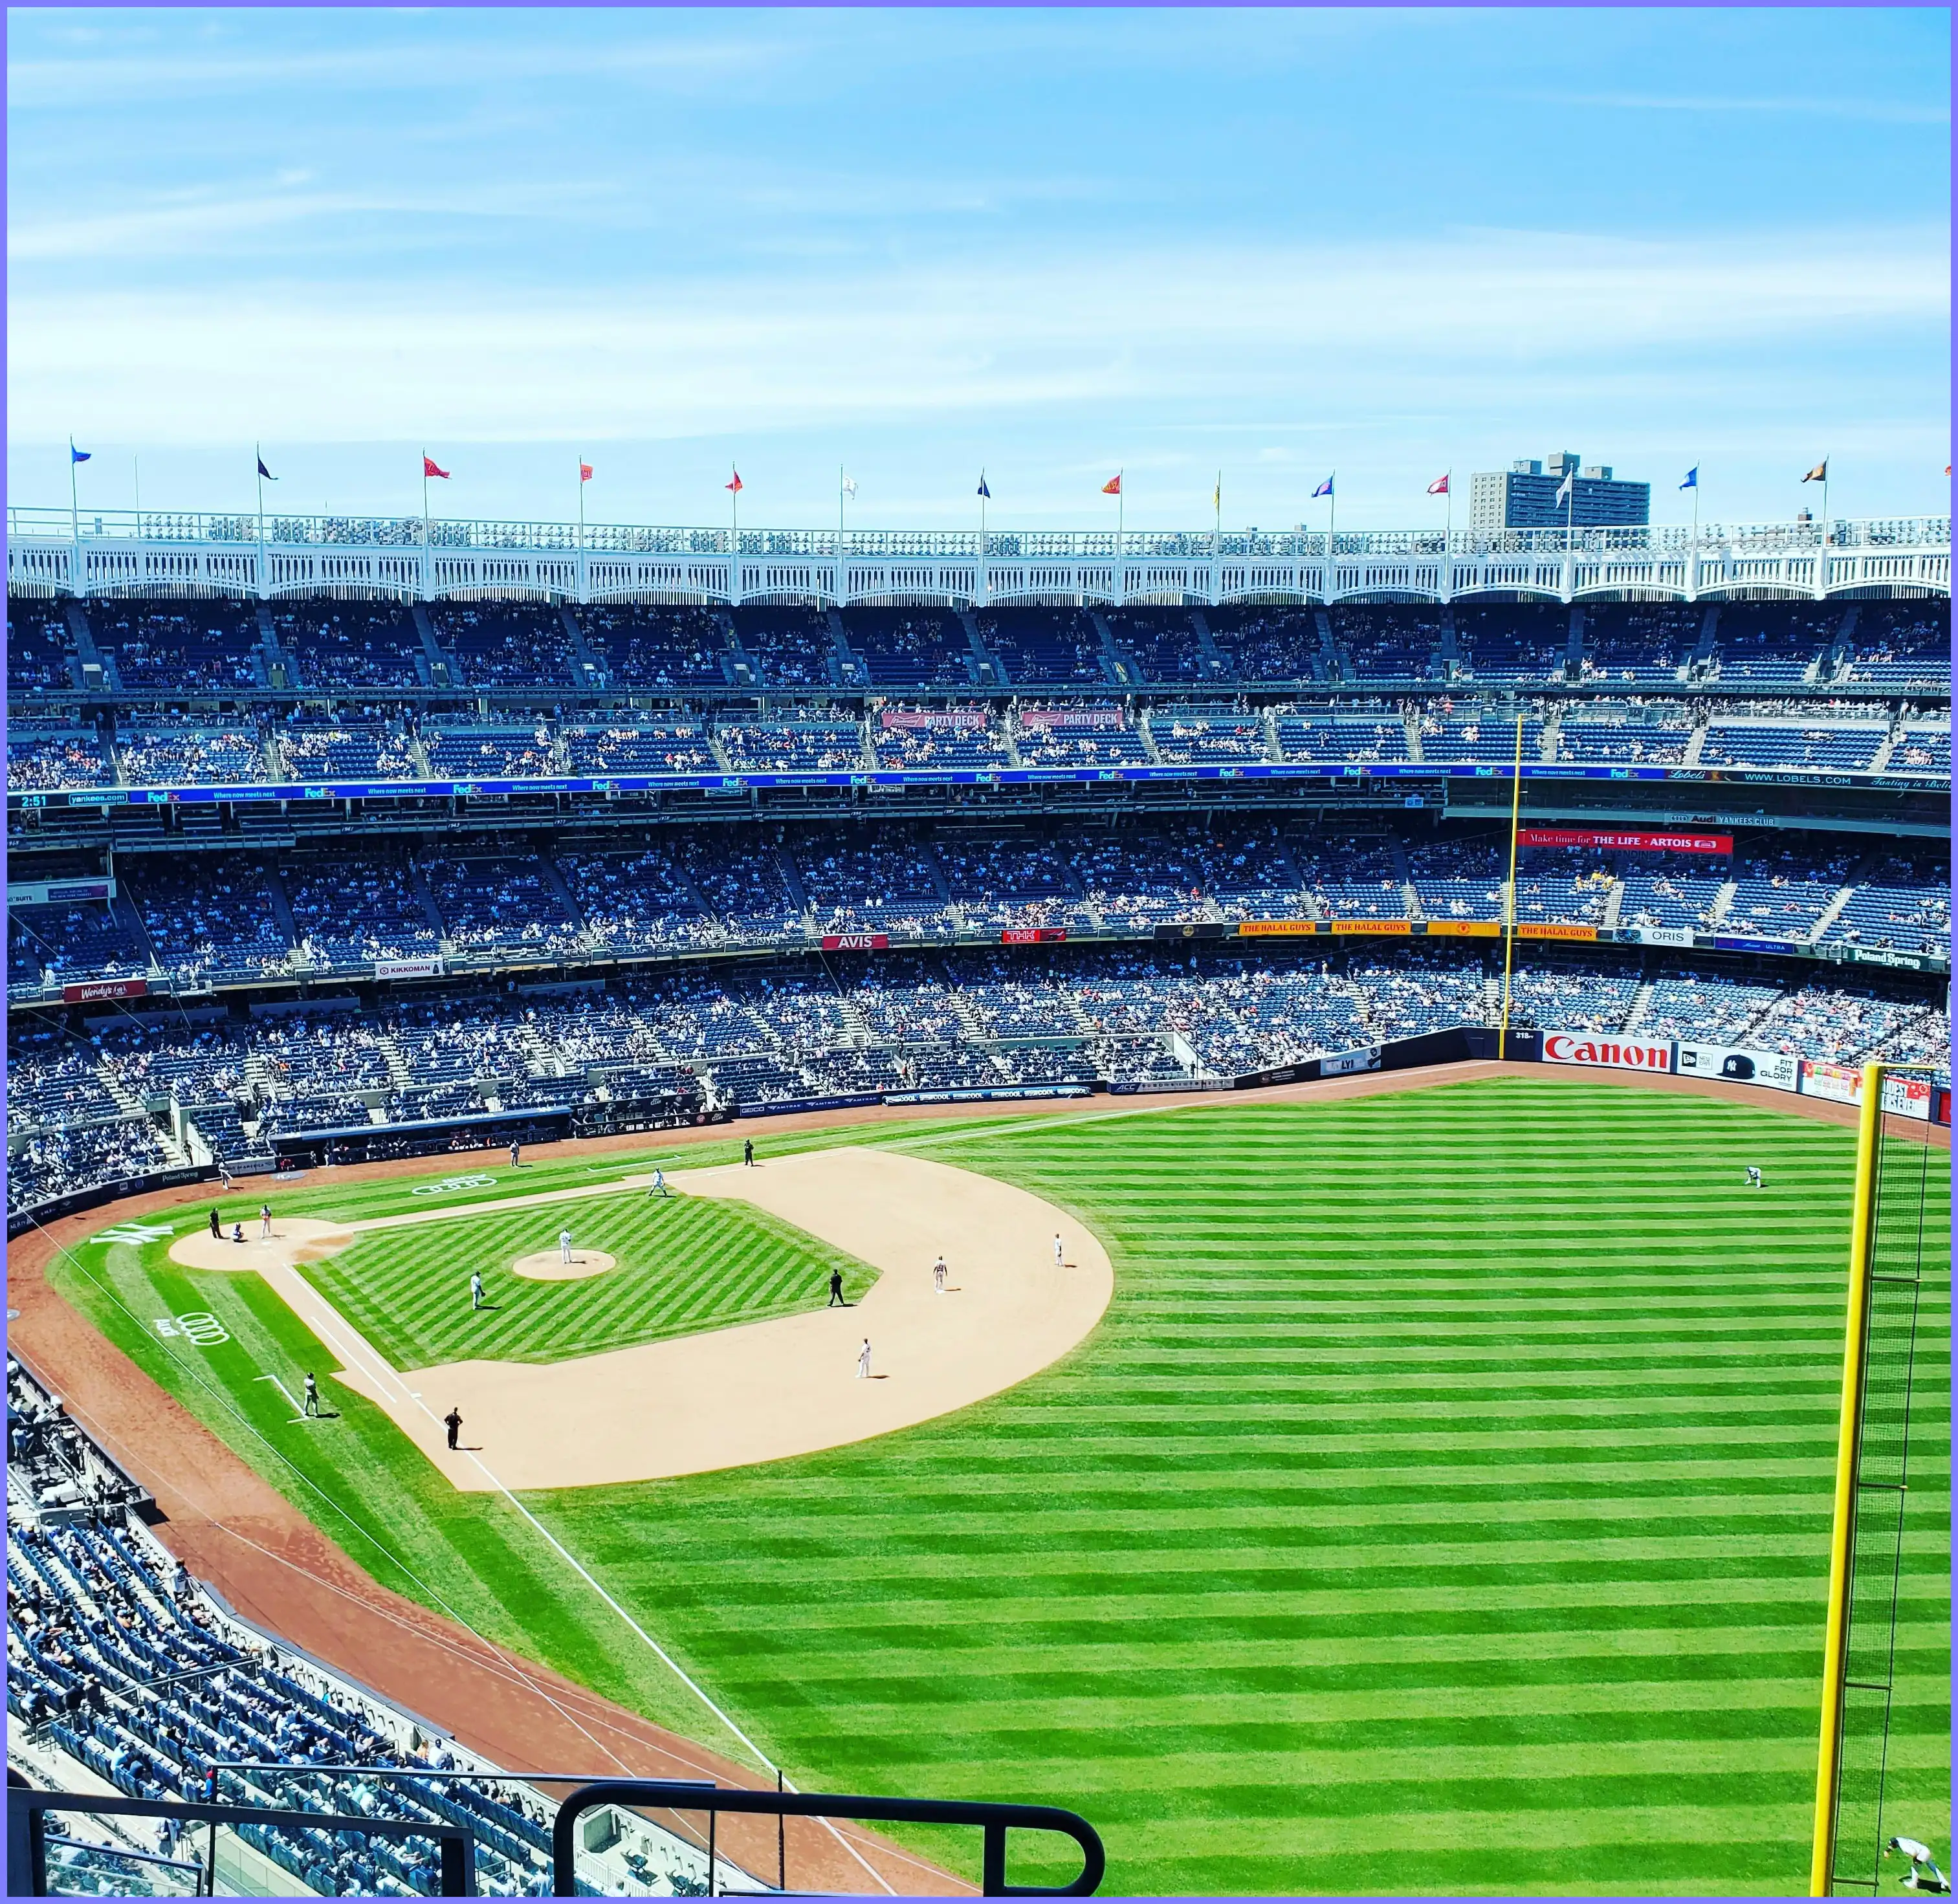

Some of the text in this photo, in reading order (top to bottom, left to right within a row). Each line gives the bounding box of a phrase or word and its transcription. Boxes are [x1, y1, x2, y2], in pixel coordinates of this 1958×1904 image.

[925, 715, 952, 726] PARTY
[955, 715, 979, 725] DECK
[1064, 714, 1092, 724] PARTY
[1094, 714, 1117, 724] DECK
[1344, 766, 1371, 775] FedEx
[1476, 767, 1504, 776] FedEx
[1611, 769, 1639, 778] FedEx
[723, 778, 748, 787] FedEx
[850, 775, 876, 784] FedEx
[1745, 773, 1851, 784] WWW.LOBELS.COM
[454, 784, 482, 794] FedEx
[593, 780, 619, 789] FedEx
[148, 791, 180, 802] FedEx
[305, 787, 335, 797] FedEx
[21, 796, 46, 807] 2:51
[72, 794, 124, 804] yankees.com
[1593, 836, 1614, 844] THE
[1618, 837, 1641, 846] LIFE
[1650, 838, 1691, 847] ARTOIS
[1007, 930, 1035, 939] THK
[1653, 931, 1684, 941] ORIS
[837, 936, 873, 948] AVIS
[1854, 949, 1920, 969] Poland Spring
[82, 985, 112, 1000] Wendy's
[1545, 1036, 1667, 1069] Canon
[1781, 1059, 1794, 1067] FIT
[1775, 1066, 1792, 1075] FOR
[1761, 1070, 1792, 1082] GLORY
[153, 1319, 180, 1338] Audi
